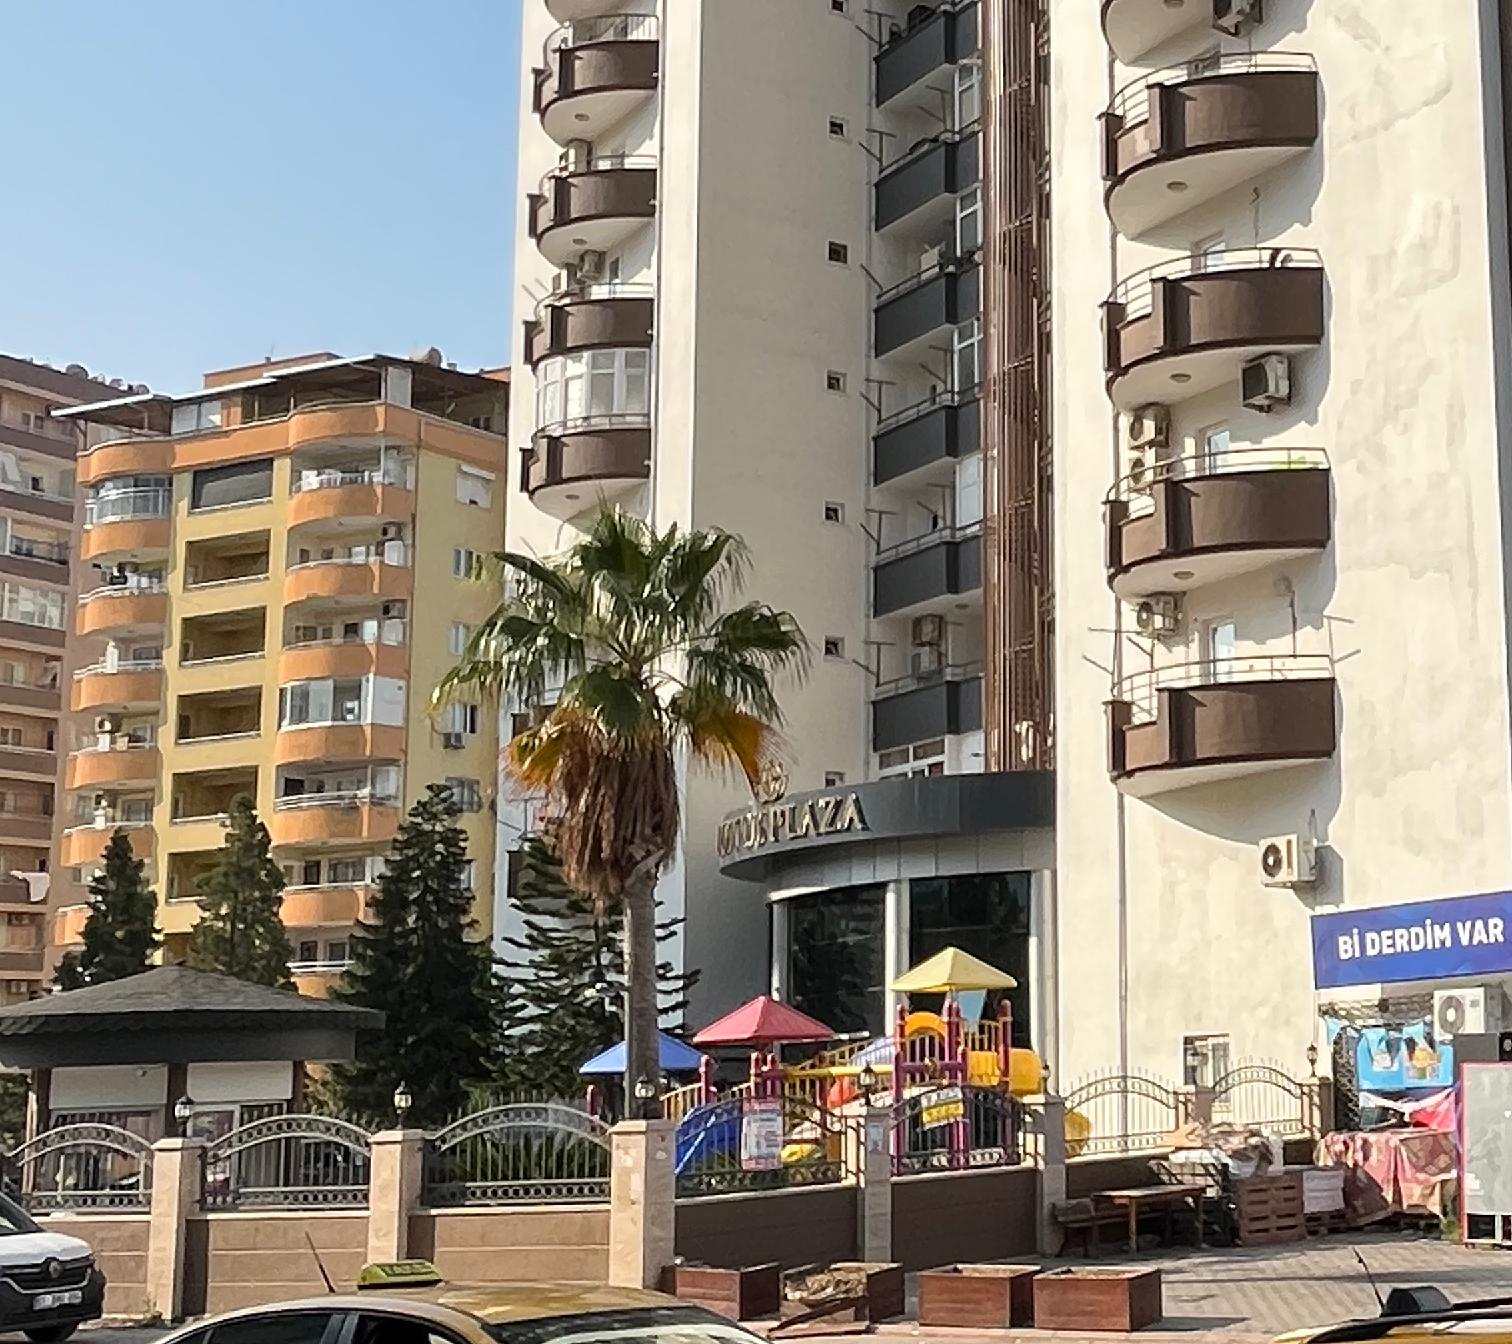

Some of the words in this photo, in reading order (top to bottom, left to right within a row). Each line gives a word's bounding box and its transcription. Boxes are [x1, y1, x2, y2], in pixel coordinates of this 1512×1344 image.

[770, 791, 872, 843] PLAZA
[1364, 918, 1451, 957] DERDİM
[1456, 916, 1505, 947] VAR
